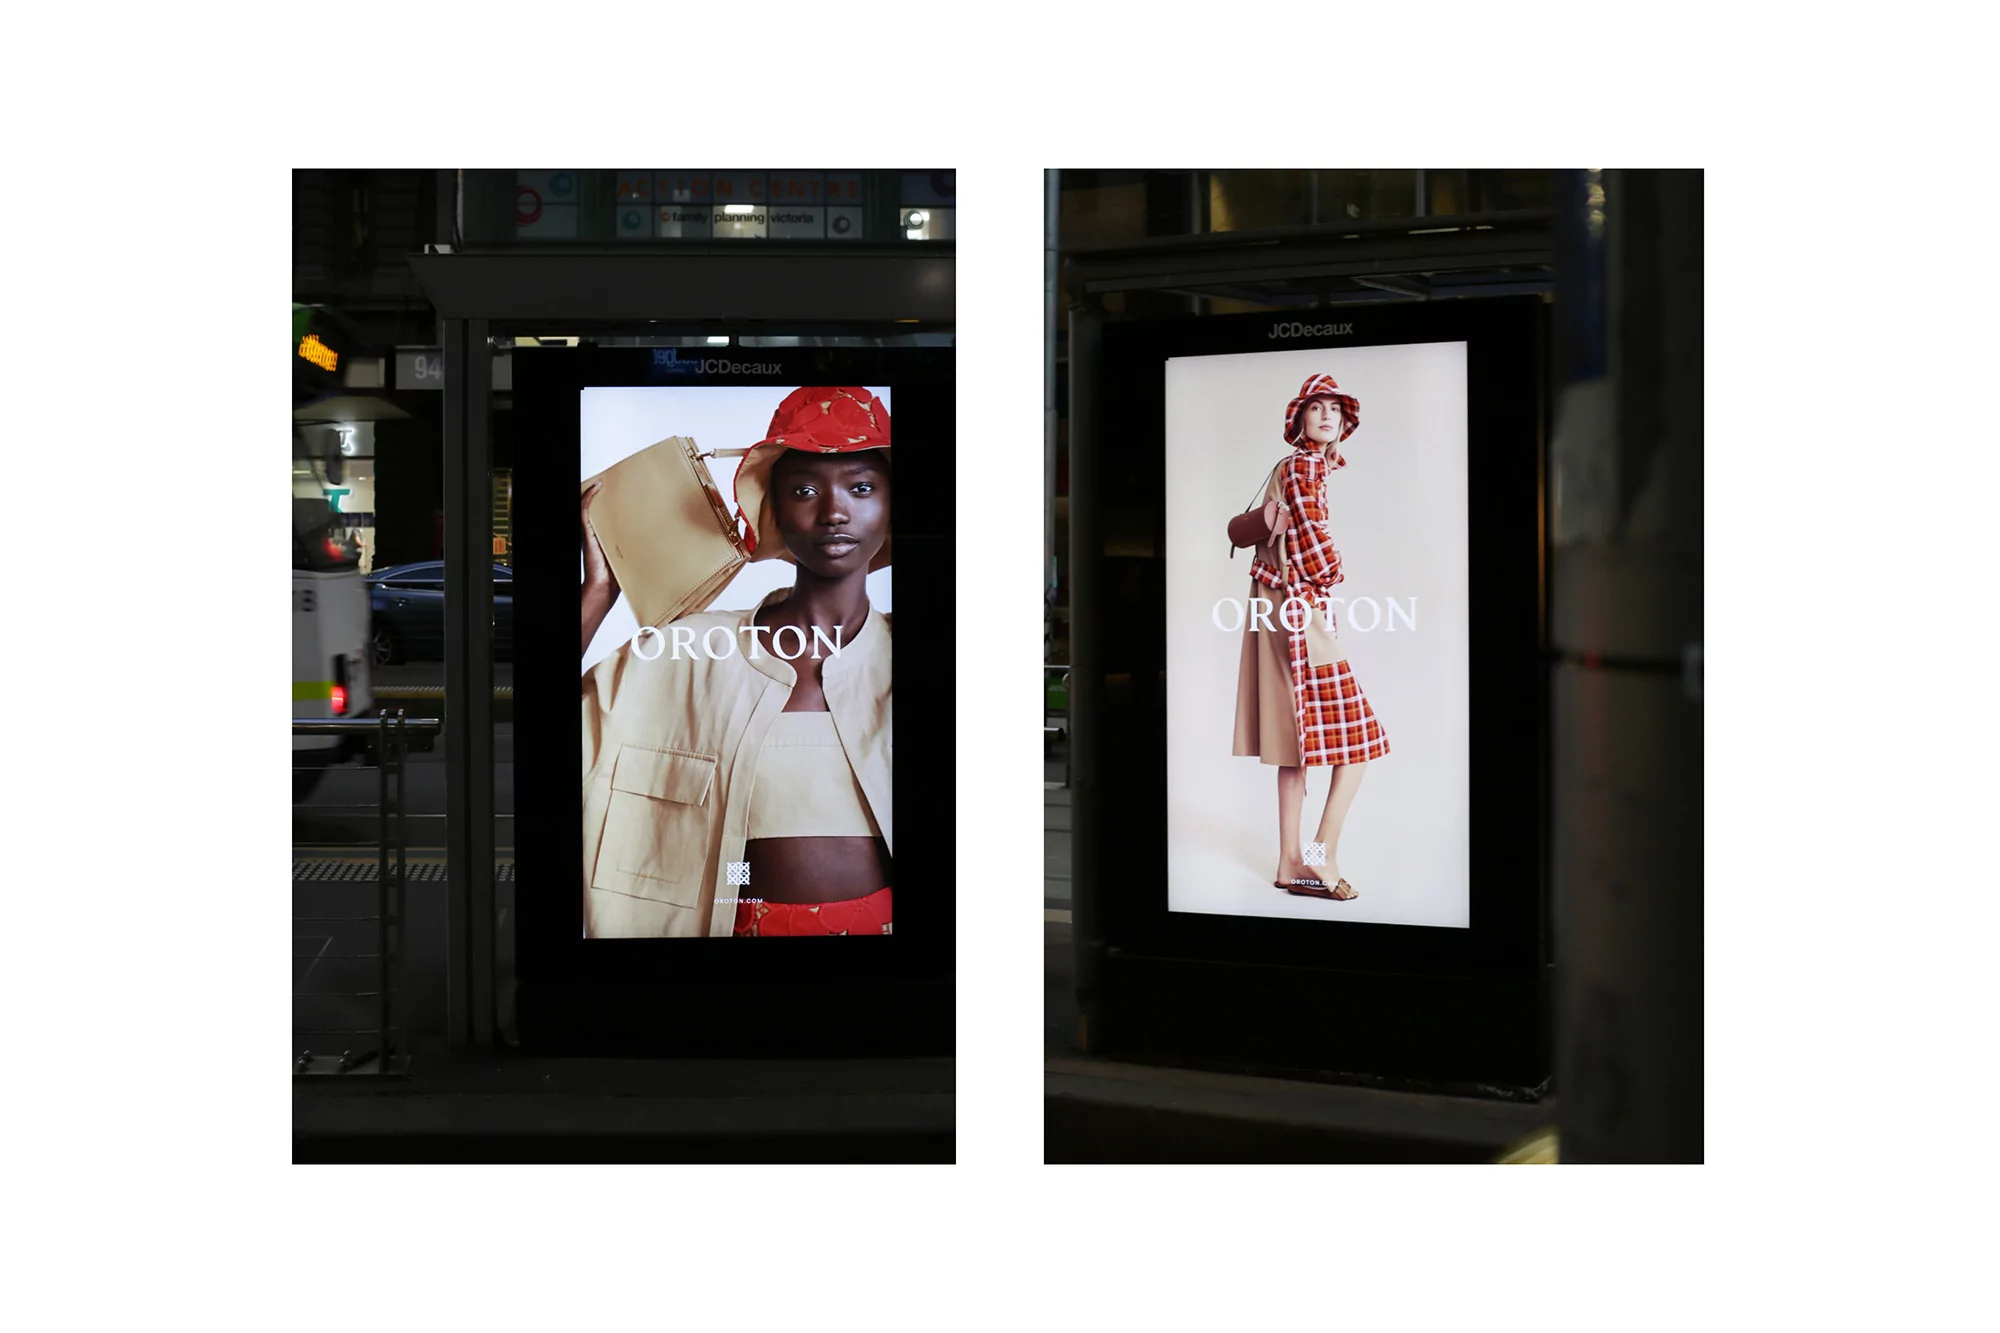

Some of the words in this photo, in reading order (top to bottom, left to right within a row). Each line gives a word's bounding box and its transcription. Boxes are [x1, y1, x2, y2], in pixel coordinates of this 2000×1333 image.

[617, 179, 733, 197] ACTION
[750, 179, 859, 197] CENTRE
[672, 211, 709, 225] family
[714, 211, 765, 225] planning
[770, 211, 814, 224] victoria
[1267, 321, 1354, 339] JCDecaux
[695, 359, 783, 375] JCDecaux
[1211, 596, 1419, 633] OROTON
[630, 624, 844, 661] OROTON
